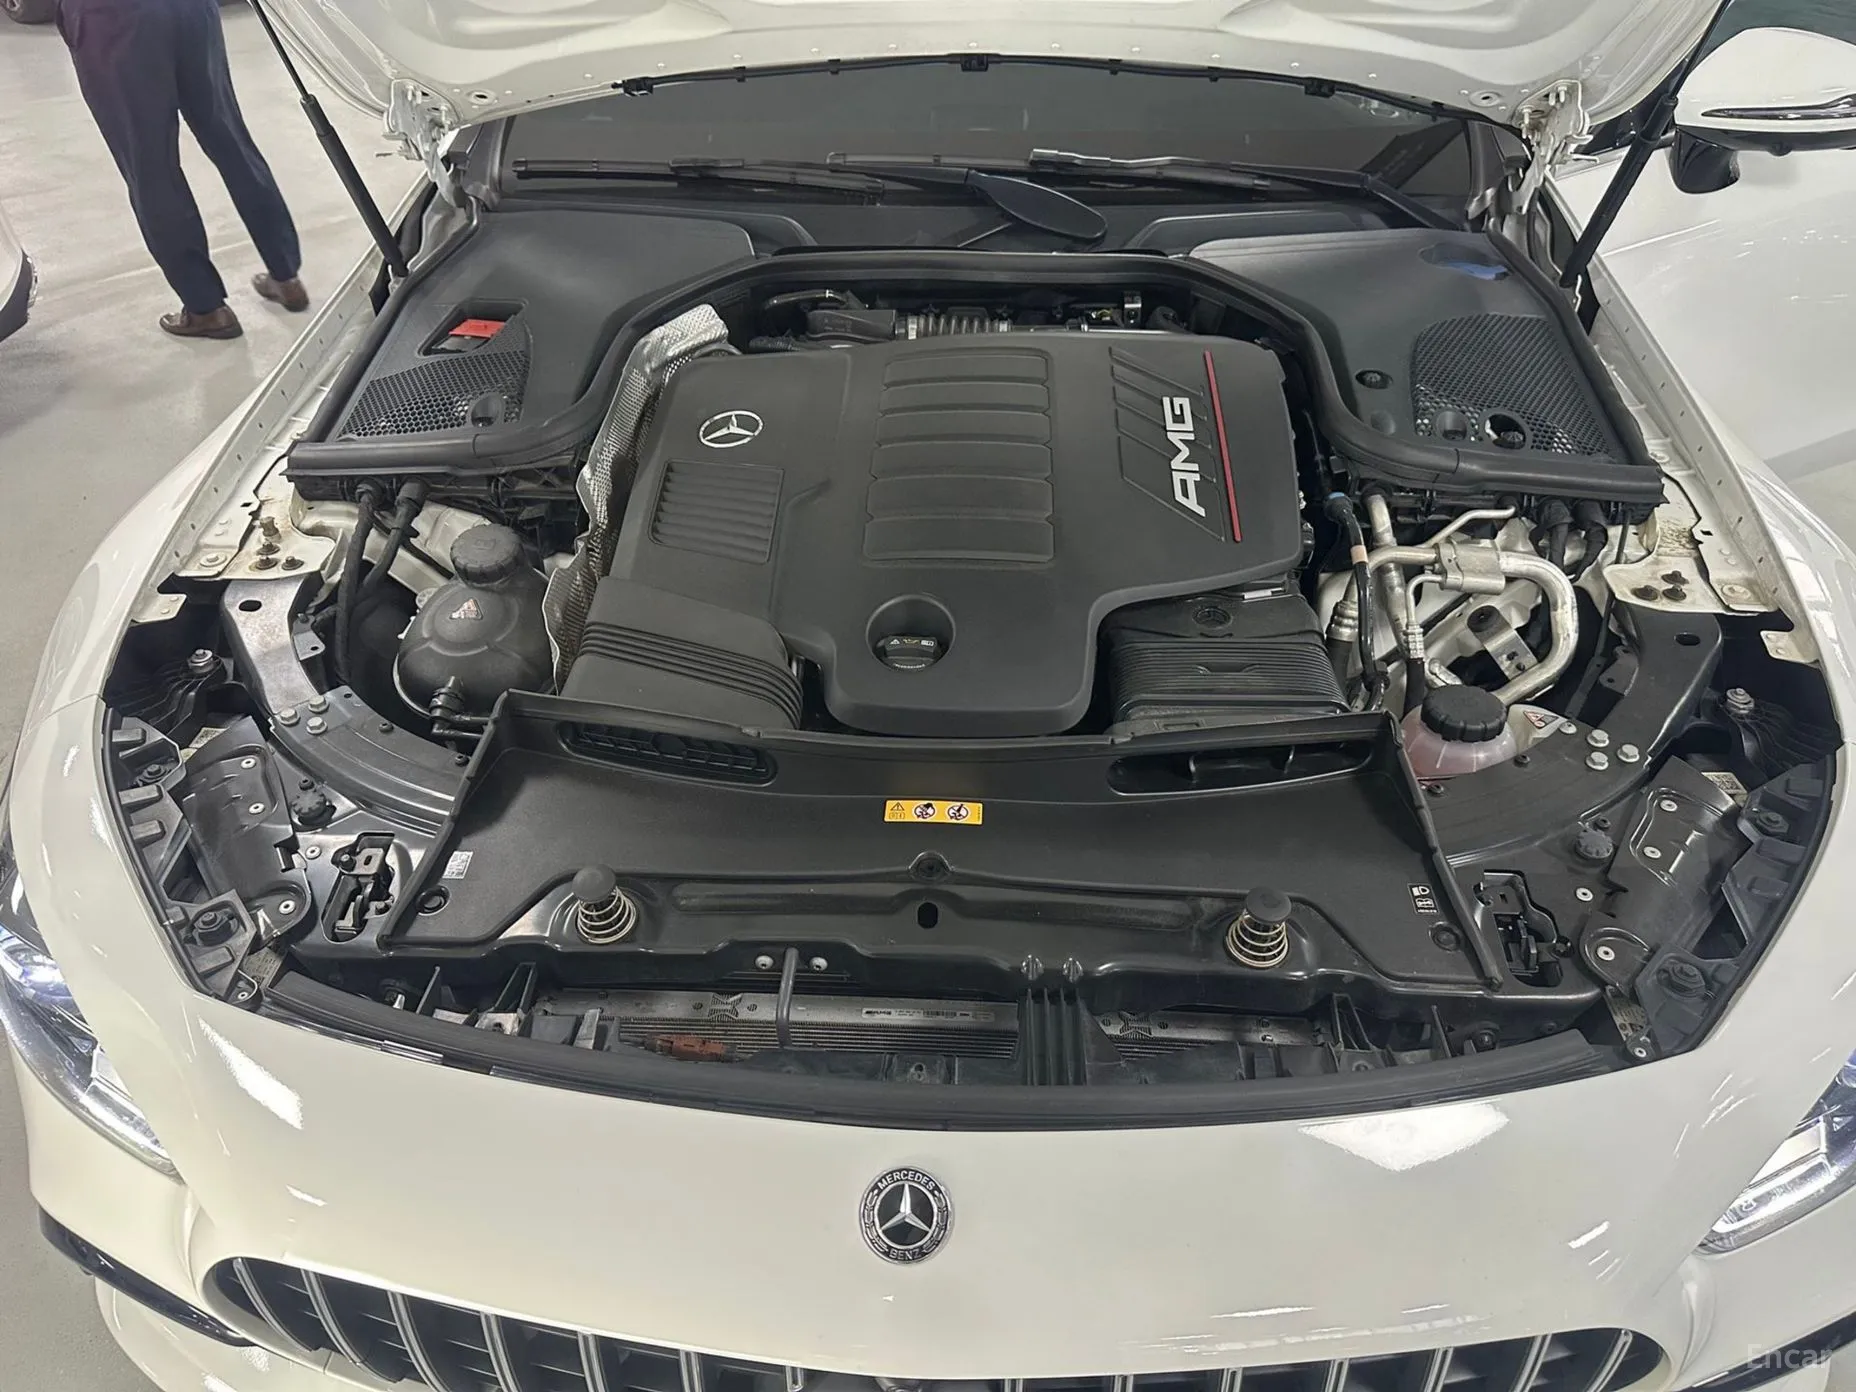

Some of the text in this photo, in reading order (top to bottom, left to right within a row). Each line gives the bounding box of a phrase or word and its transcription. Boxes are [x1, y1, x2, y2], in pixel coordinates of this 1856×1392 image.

[1162, 396, 1206, 517] AMG
[877, 1170, 936, 1191] MERCEDES
[888, 1248, 922, 1261] BENZ
